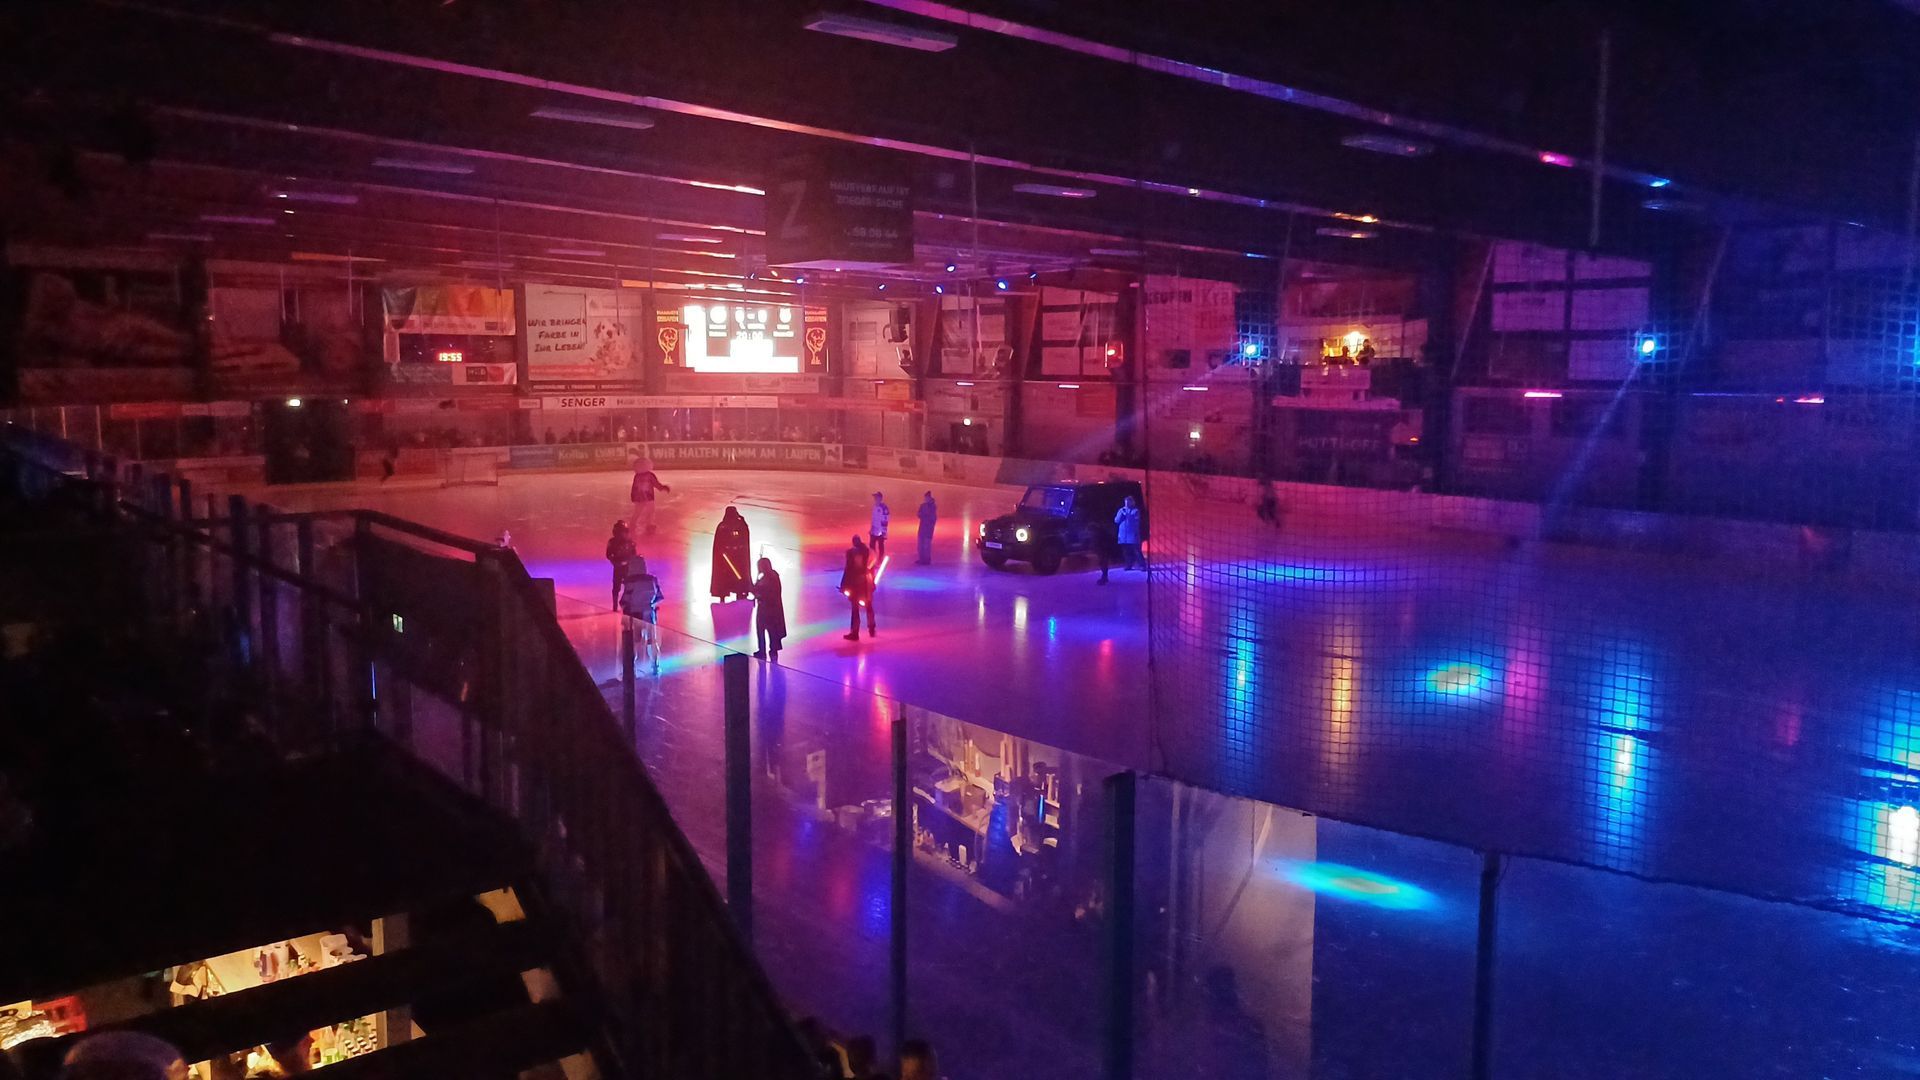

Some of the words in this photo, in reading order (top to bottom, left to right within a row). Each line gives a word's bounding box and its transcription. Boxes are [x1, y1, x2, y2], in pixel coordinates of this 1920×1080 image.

[527, 319, 547, 327] WIR
[550, 318, 586, 326] BRINGEN
[538, 331, 567, 339] FARBE
[534, 343, 552, 353] IHR
[439, 352, 462, 361] 19:55
[561, 398, 606, 407] SENGER
[653, 448, 676, 459] WIR
[679, 447, 719, 459] HALTEN
[722, 447, 756, 460] HAMM
[760, 448, 776, 459] AM
[785, 448, 821, 461] LAUFEN
